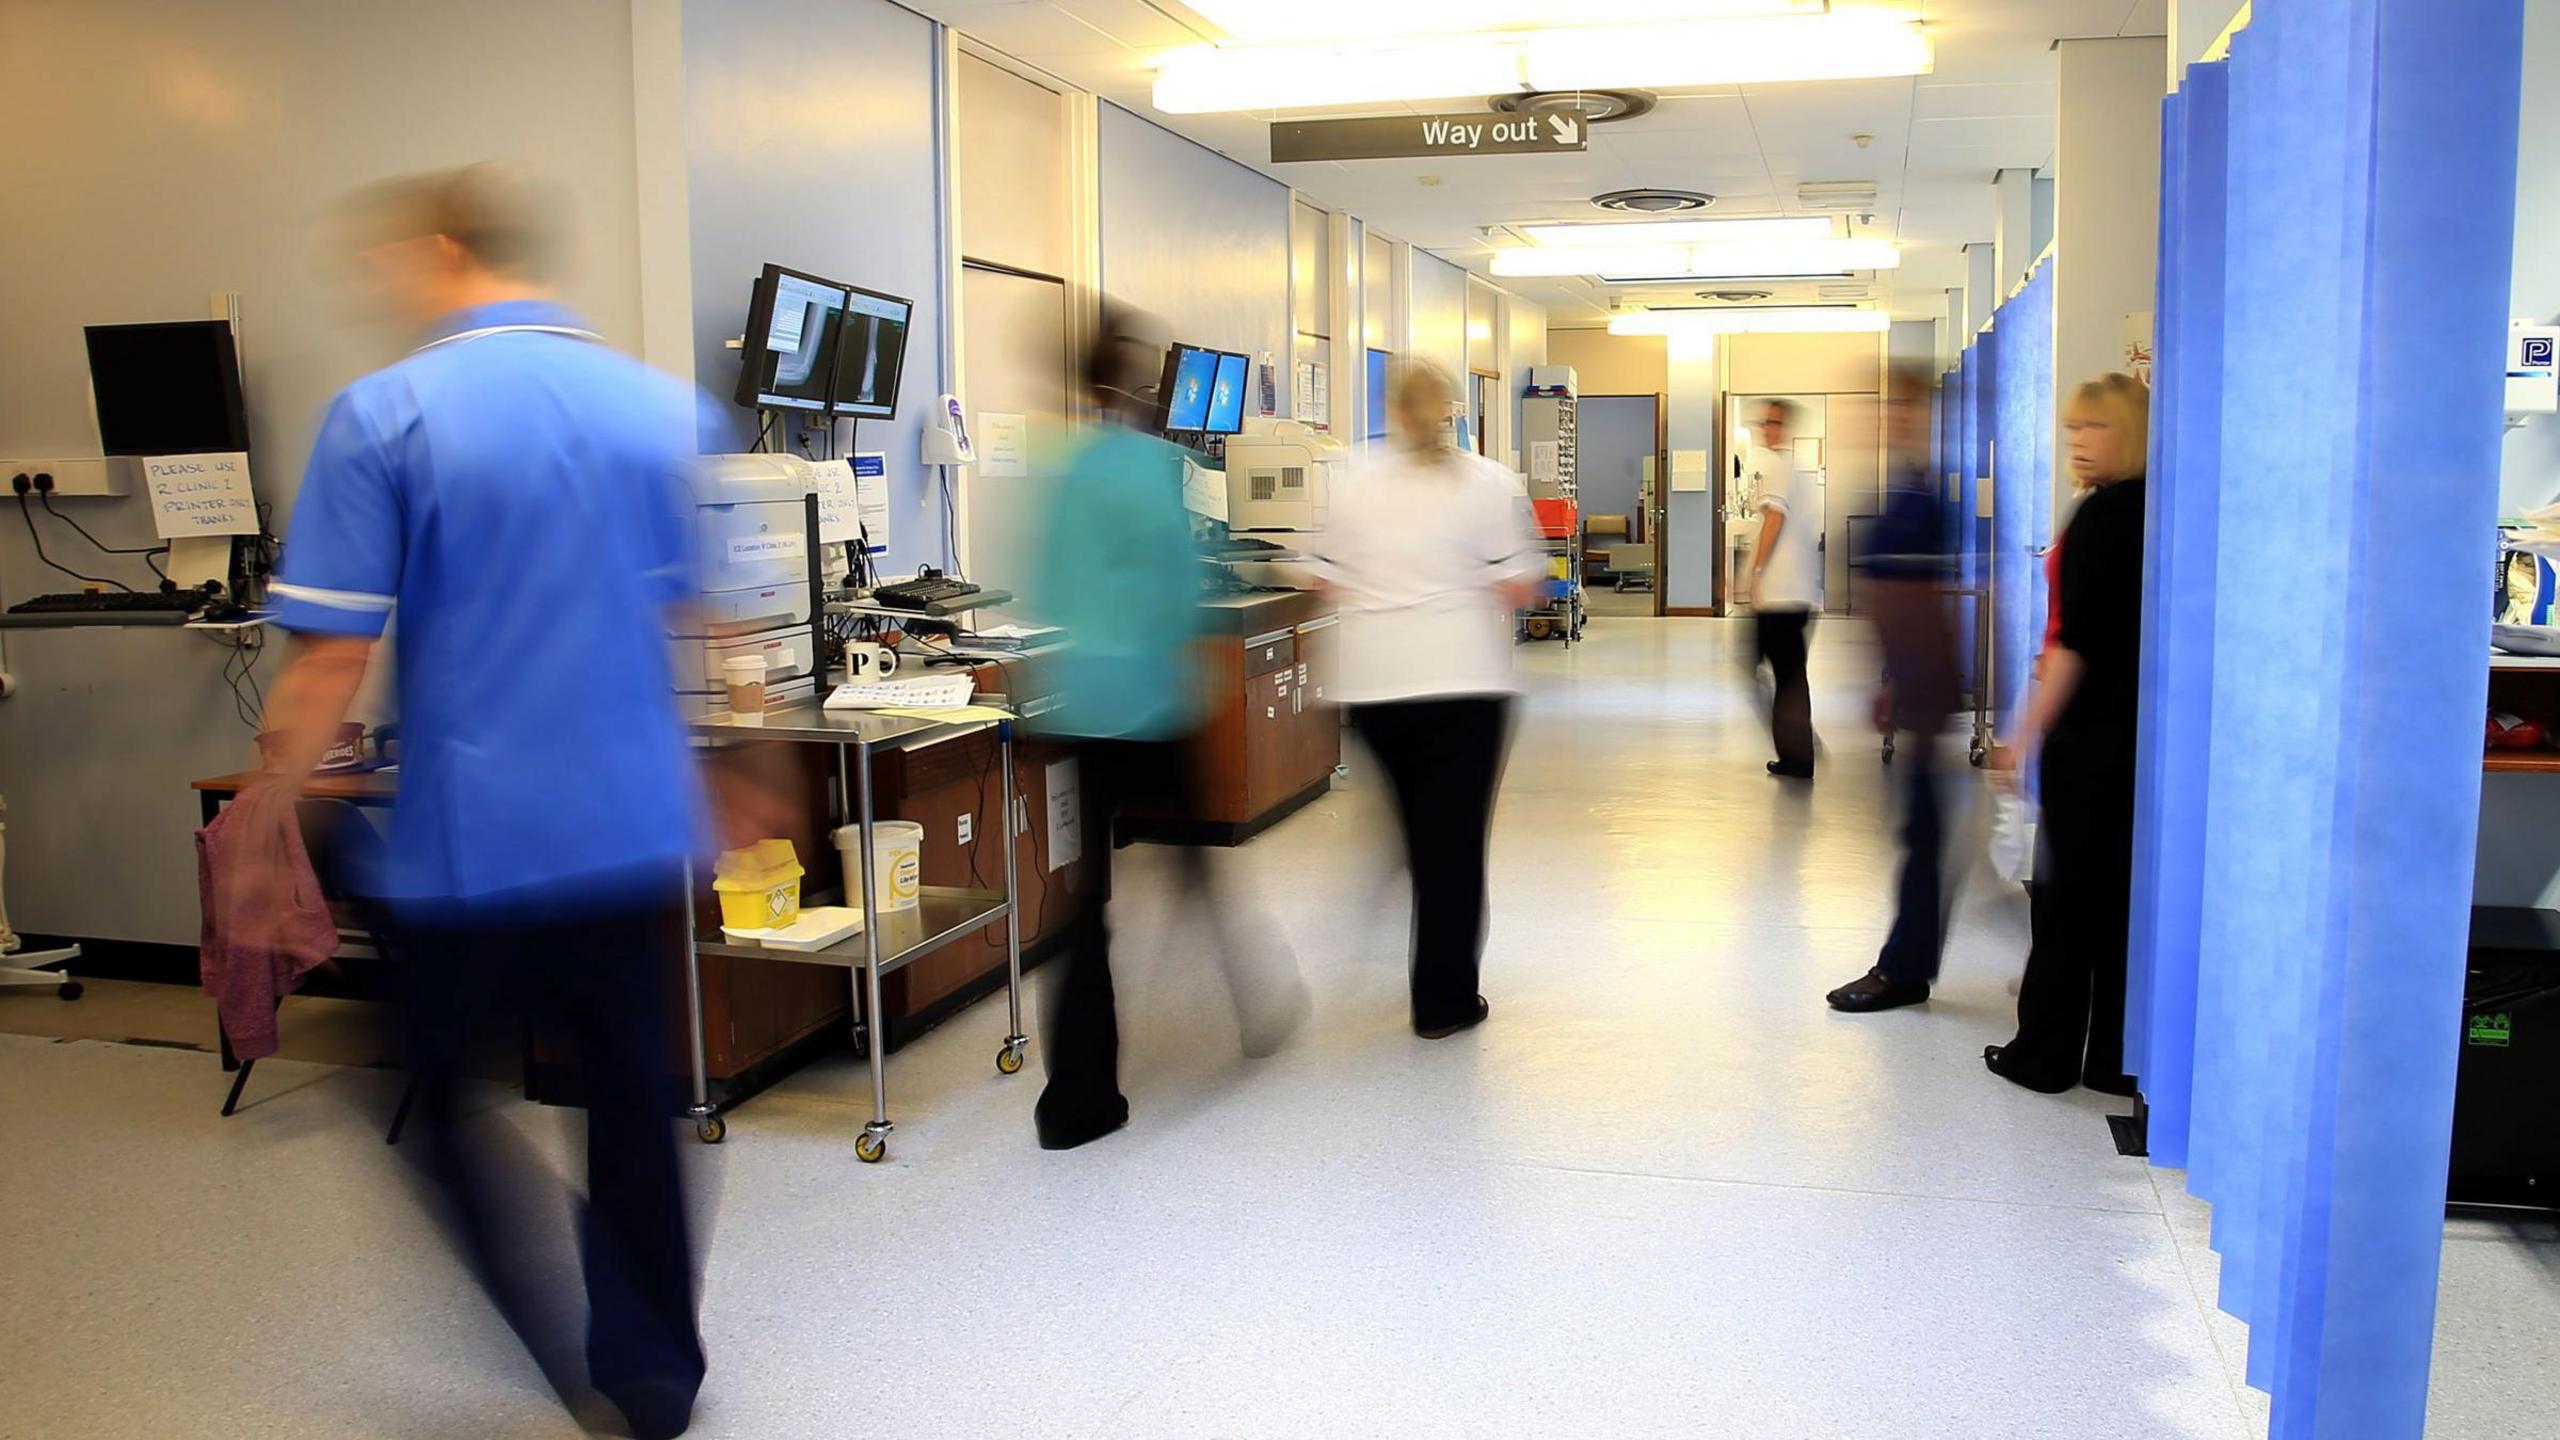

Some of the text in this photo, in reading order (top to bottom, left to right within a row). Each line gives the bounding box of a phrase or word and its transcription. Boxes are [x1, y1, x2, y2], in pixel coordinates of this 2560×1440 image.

[1422, 116, 1538, 149] Way out
[150, 461, 237, 477] PLEASE USE
[177, 480, 218, 493] CLINIC
[163, 498, 226, 512] PRINTER
[850, 652, 869, 676] P
